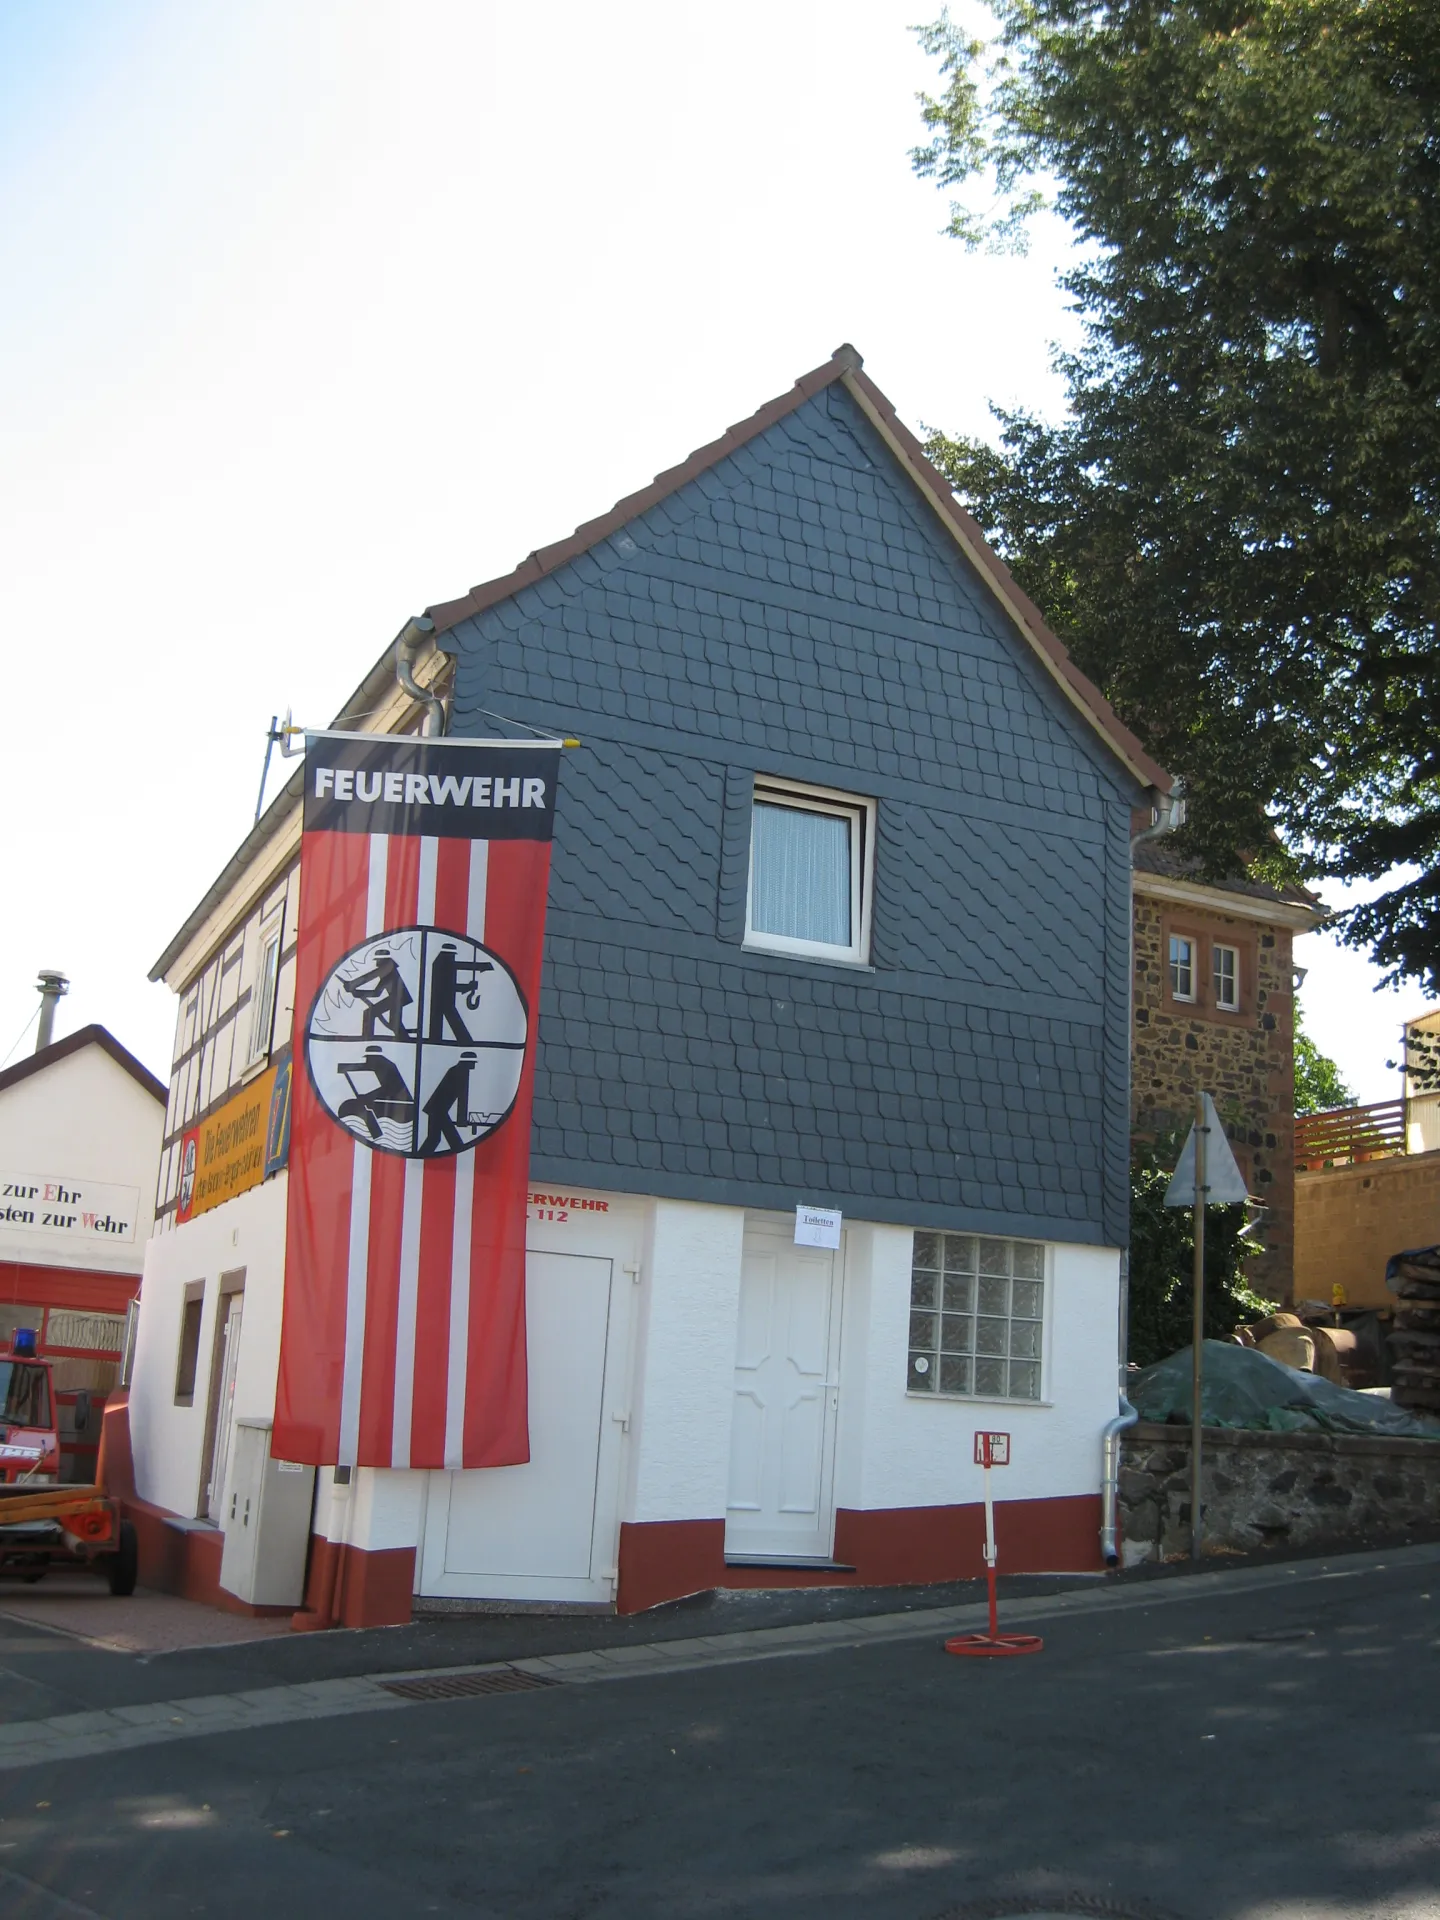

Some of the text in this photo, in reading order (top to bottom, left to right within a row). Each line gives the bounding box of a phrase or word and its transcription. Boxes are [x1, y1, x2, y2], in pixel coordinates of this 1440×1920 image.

[315, 768, 546, 810] FEUERWEHR
[2, 1184, 81, 1204] zur Ehr
[42, 1213, 76, 1228] zur
[82, 1213, 128, 1234] Wehr
[537, 1209, 568, 1222] 112
[804, 1215, 834, 1226] Toiletten
